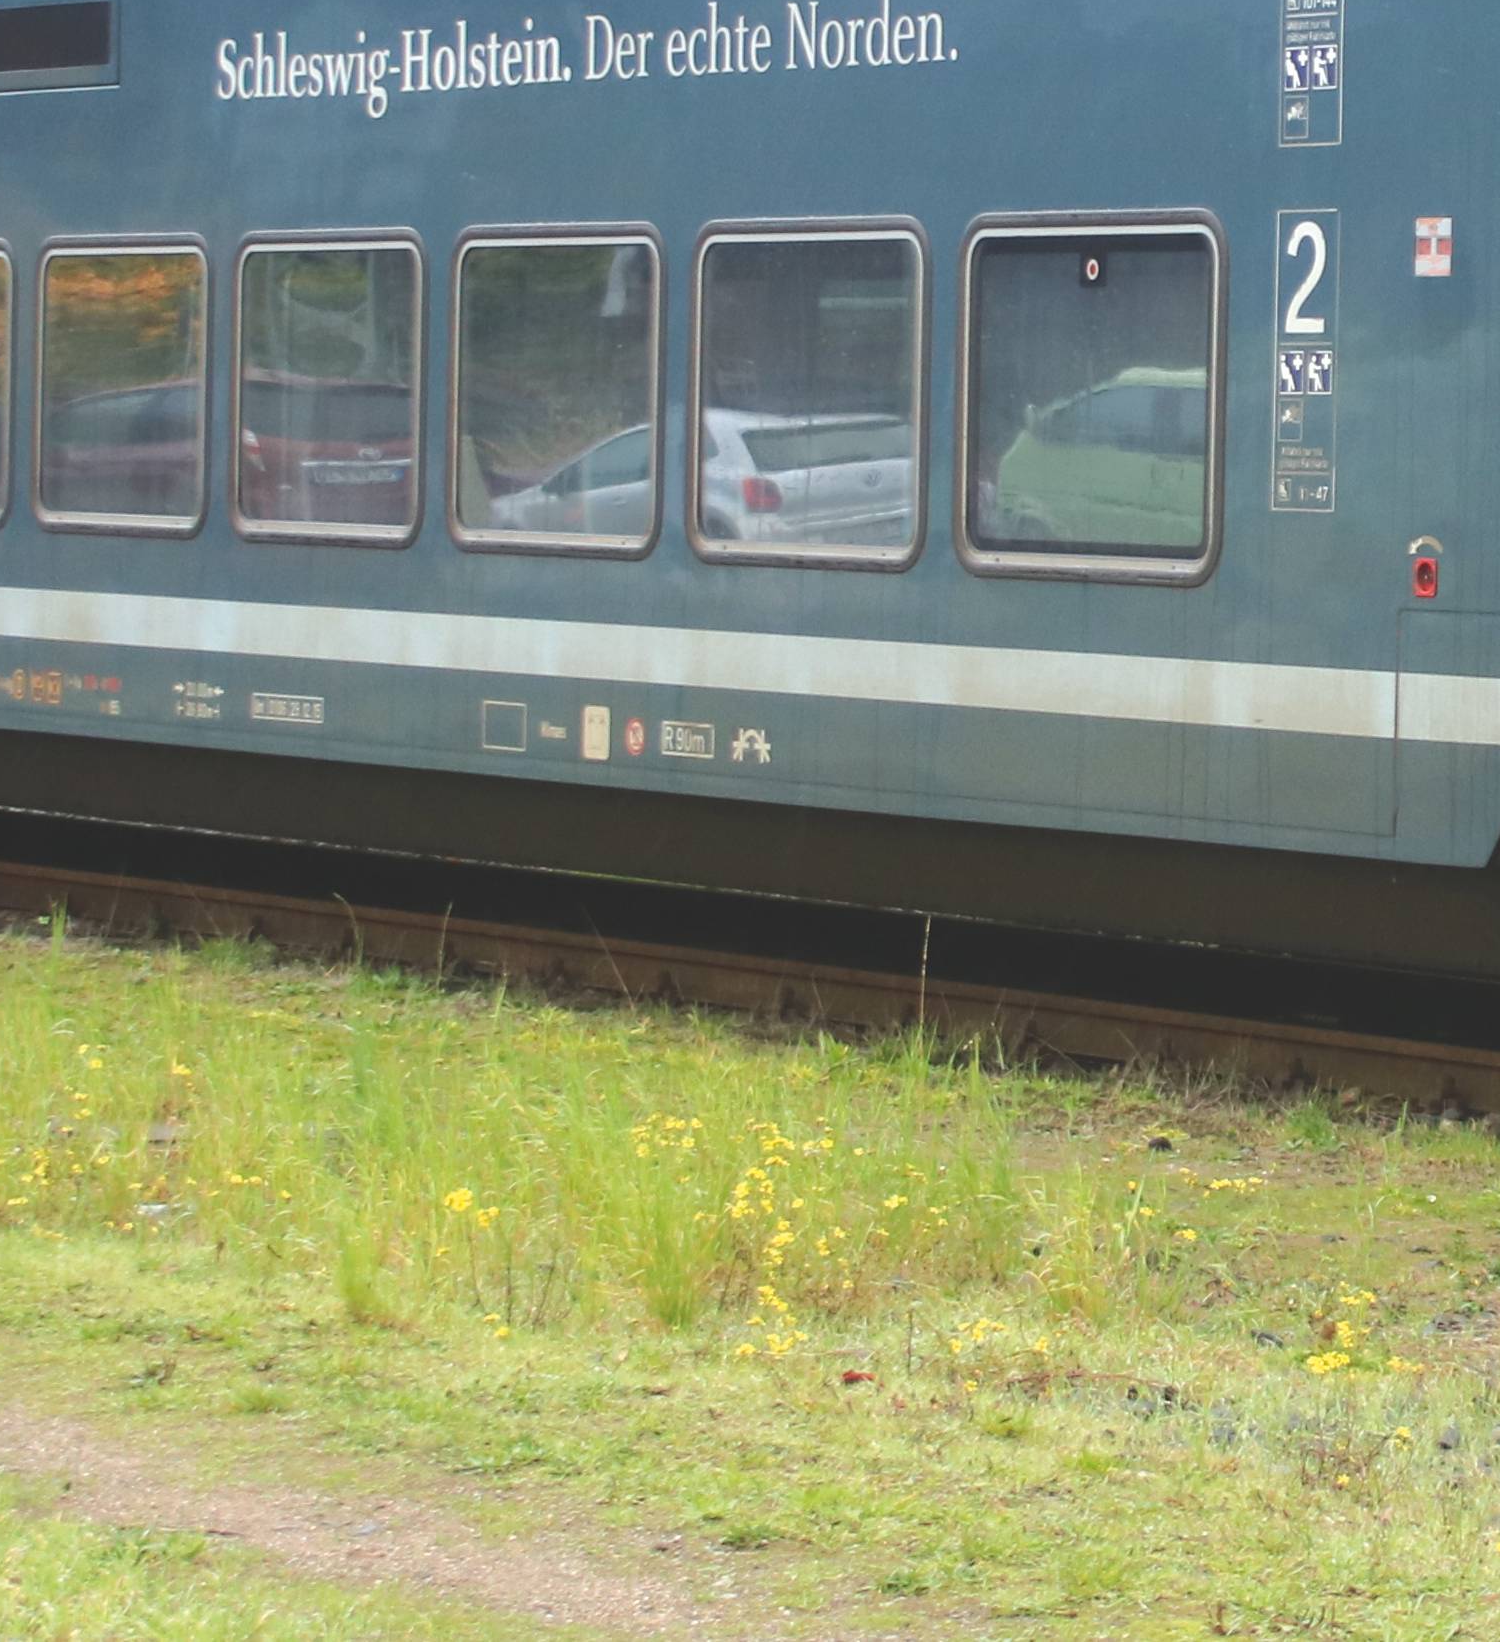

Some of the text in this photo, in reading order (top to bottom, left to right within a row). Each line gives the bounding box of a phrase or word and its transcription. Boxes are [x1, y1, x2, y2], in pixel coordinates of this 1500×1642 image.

[215, 17, 572, 119] Schleswig-Holstein.
[583, 14, 655, 81] Der
[665, 0, 772, 77] echte
[1285, 221, 1326, 334] 2
